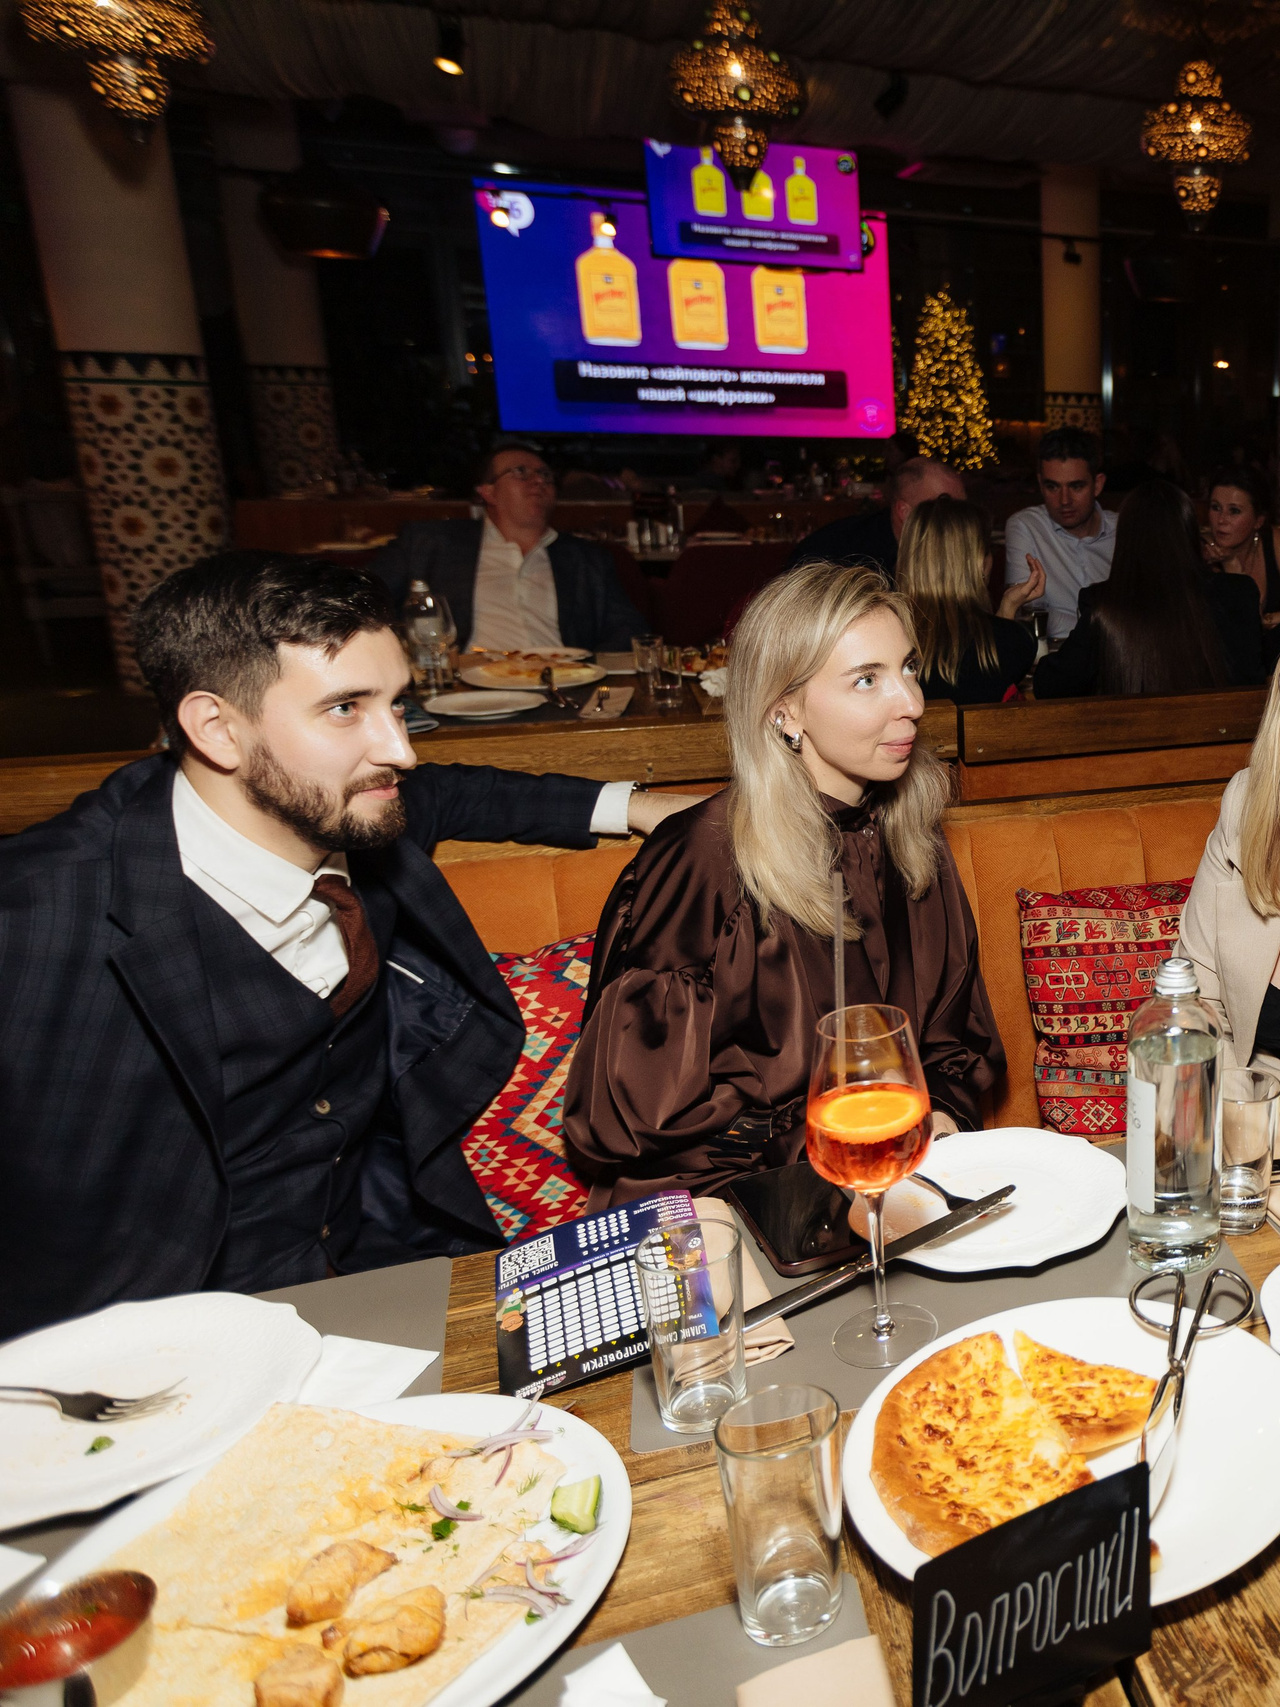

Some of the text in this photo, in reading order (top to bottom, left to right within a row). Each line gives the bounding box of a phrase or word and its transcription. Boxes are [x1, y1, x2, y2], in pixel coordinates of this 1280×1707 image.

[577, 360, 650, 381] Назовите
[740, 370, 826, 386] исполнителя
[637, 385, 776, 406] нашей «шифровки»
[633, 1199, 689, 1215] ОБСЛУЖИВАНИЕ
[656, 1203, 690, 1213] ЛОКАЦИЯ
[657, 1212, 693, 1223] ВОПРОСЫ
[531, 1260, 559, 1276] ЗАПИСЬ
[680, 1323, 707, 1340] БЛАНК
